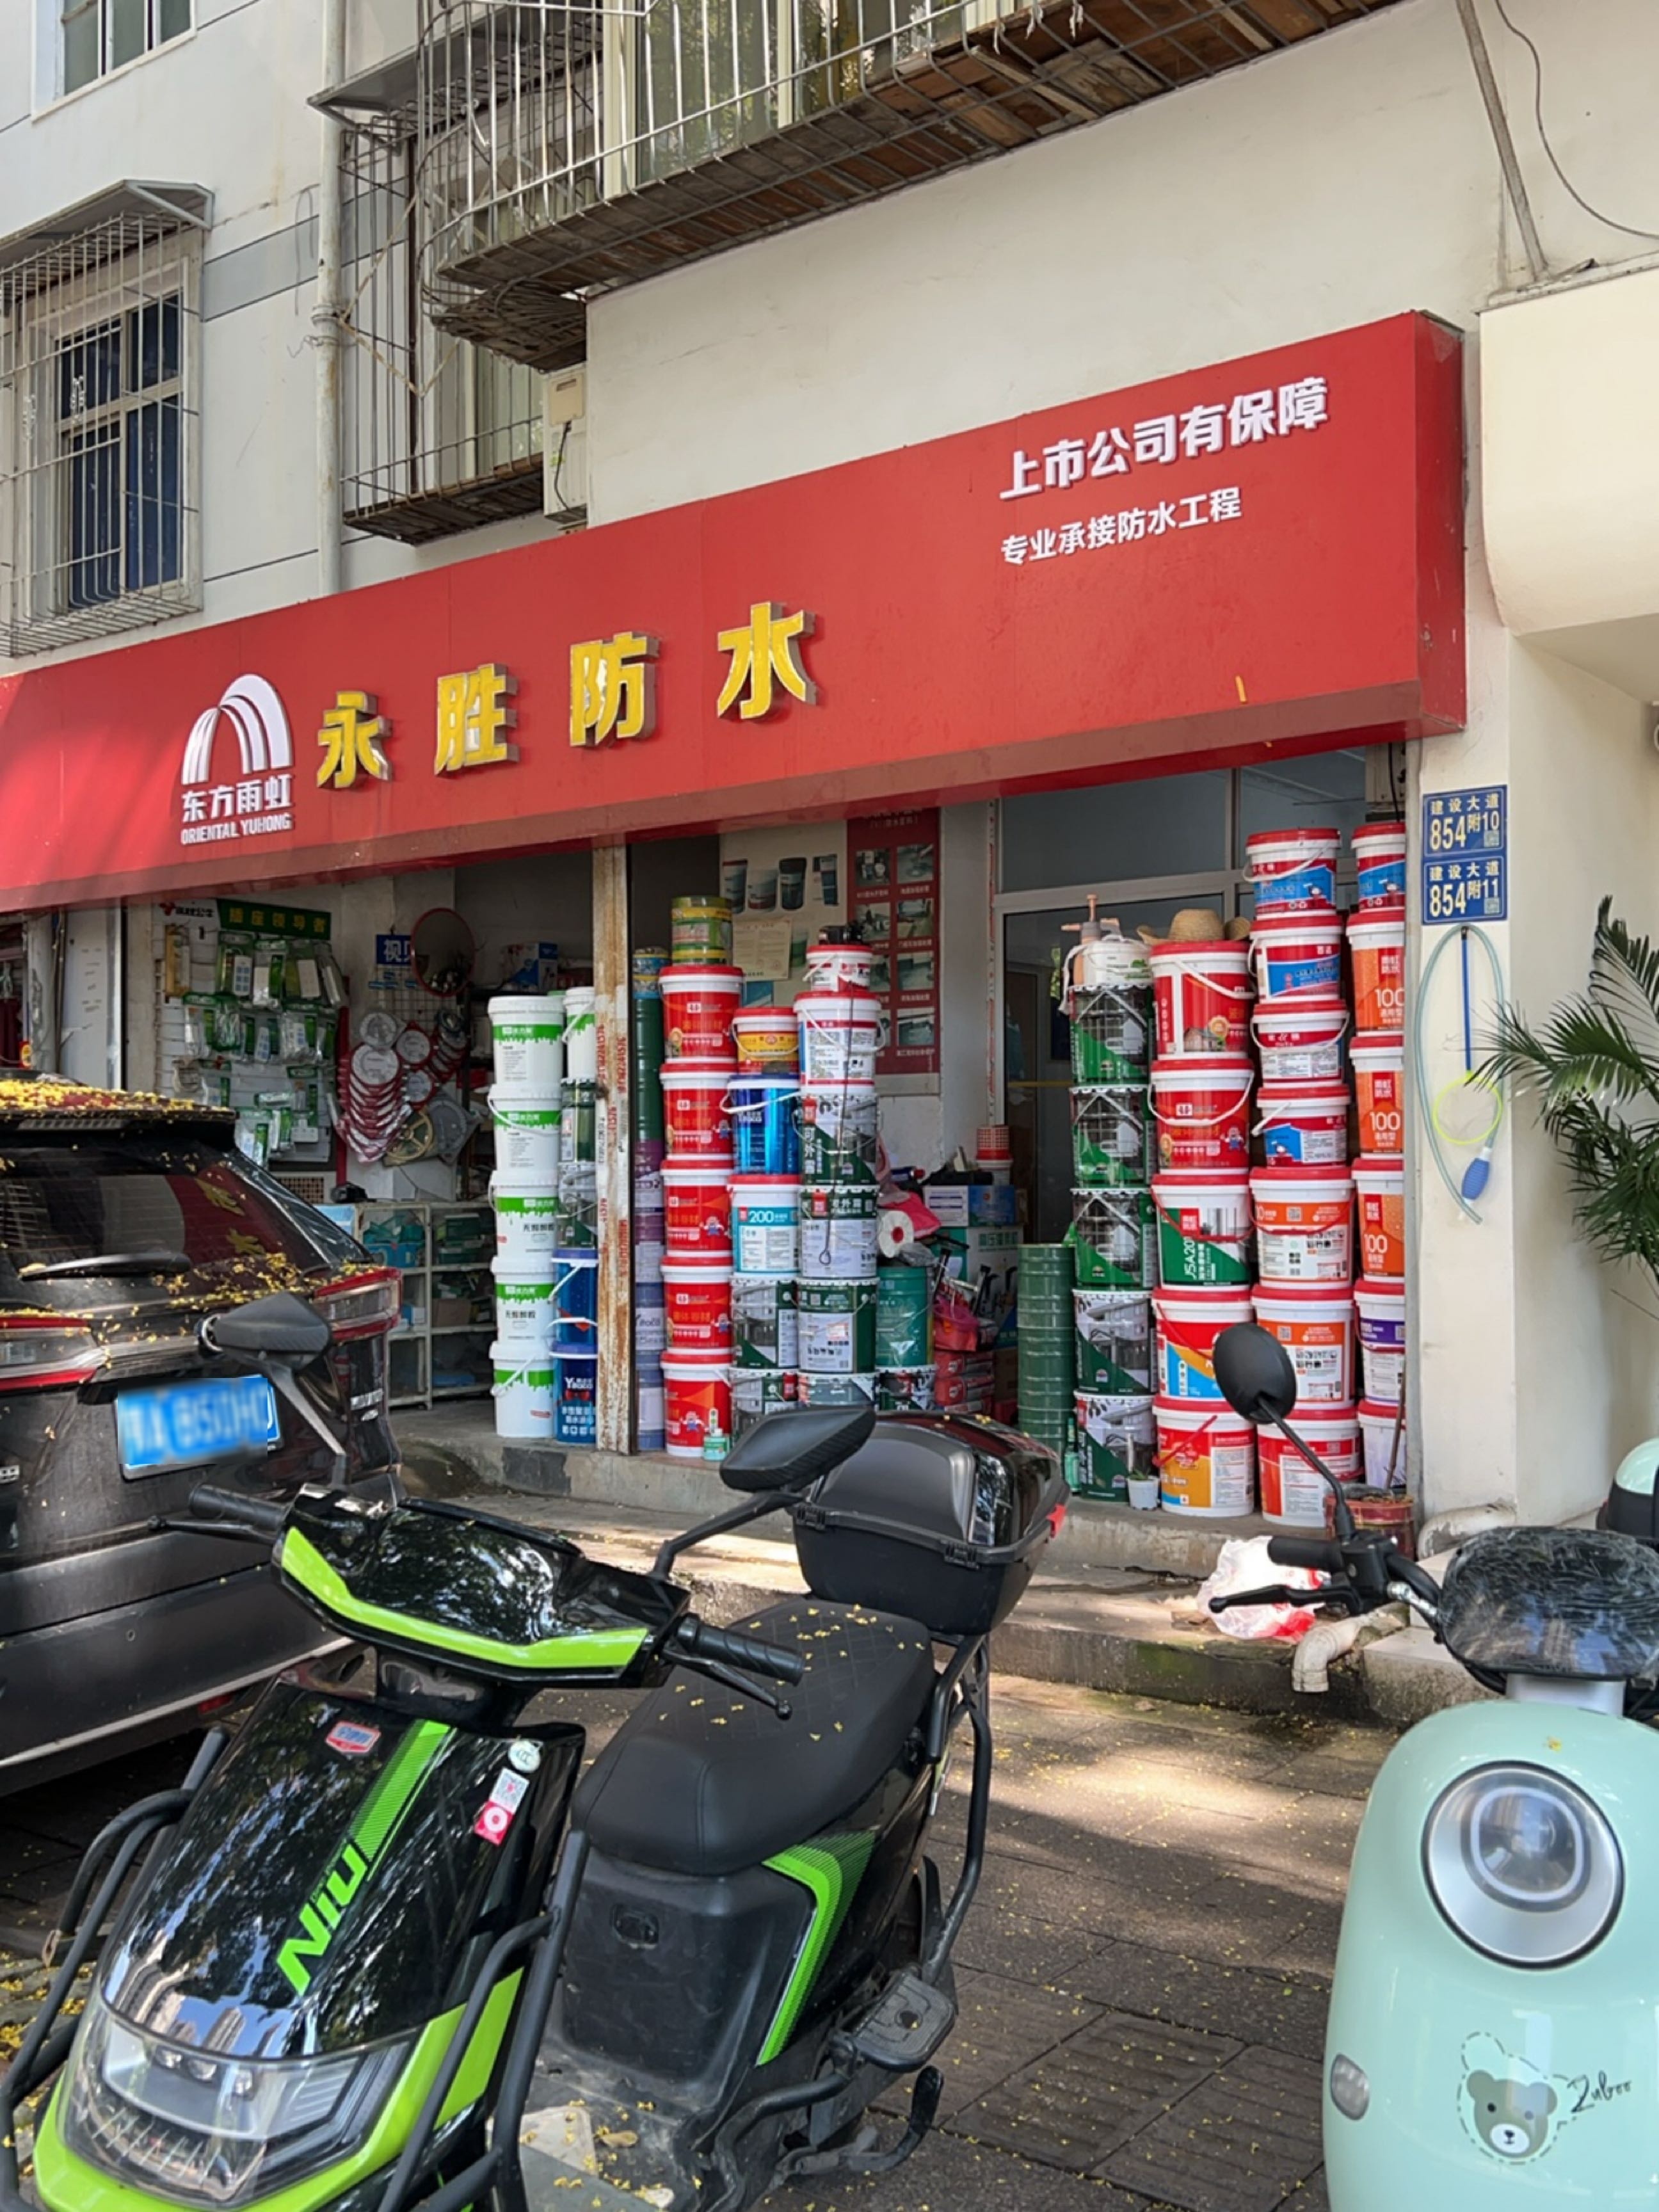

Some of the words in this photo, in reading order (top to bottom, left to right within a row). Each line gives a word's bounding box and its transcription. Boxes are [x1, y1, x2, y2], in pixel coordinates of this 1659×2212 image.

[1000, 377, 1328, 501] 上市公司有保障
[1001, 487, 1241, 566] 专业承接防水工程
[316, 601, 817, 790] 永胜防水
[180, 773, 293, 823] 东方雨虹
[1430, 793, 1499, 815] 建设大道
[180, 821, 241, 846] ORIENTAL
[239, 811, 294, 837] YUHONG
[1429, 861, 1499, 882] 建设大道
[1370, 1112, 1400, 1131] 100
[748, 1210, 774, 1223] 200
[1364, 1234, 1388, 1254] 100
